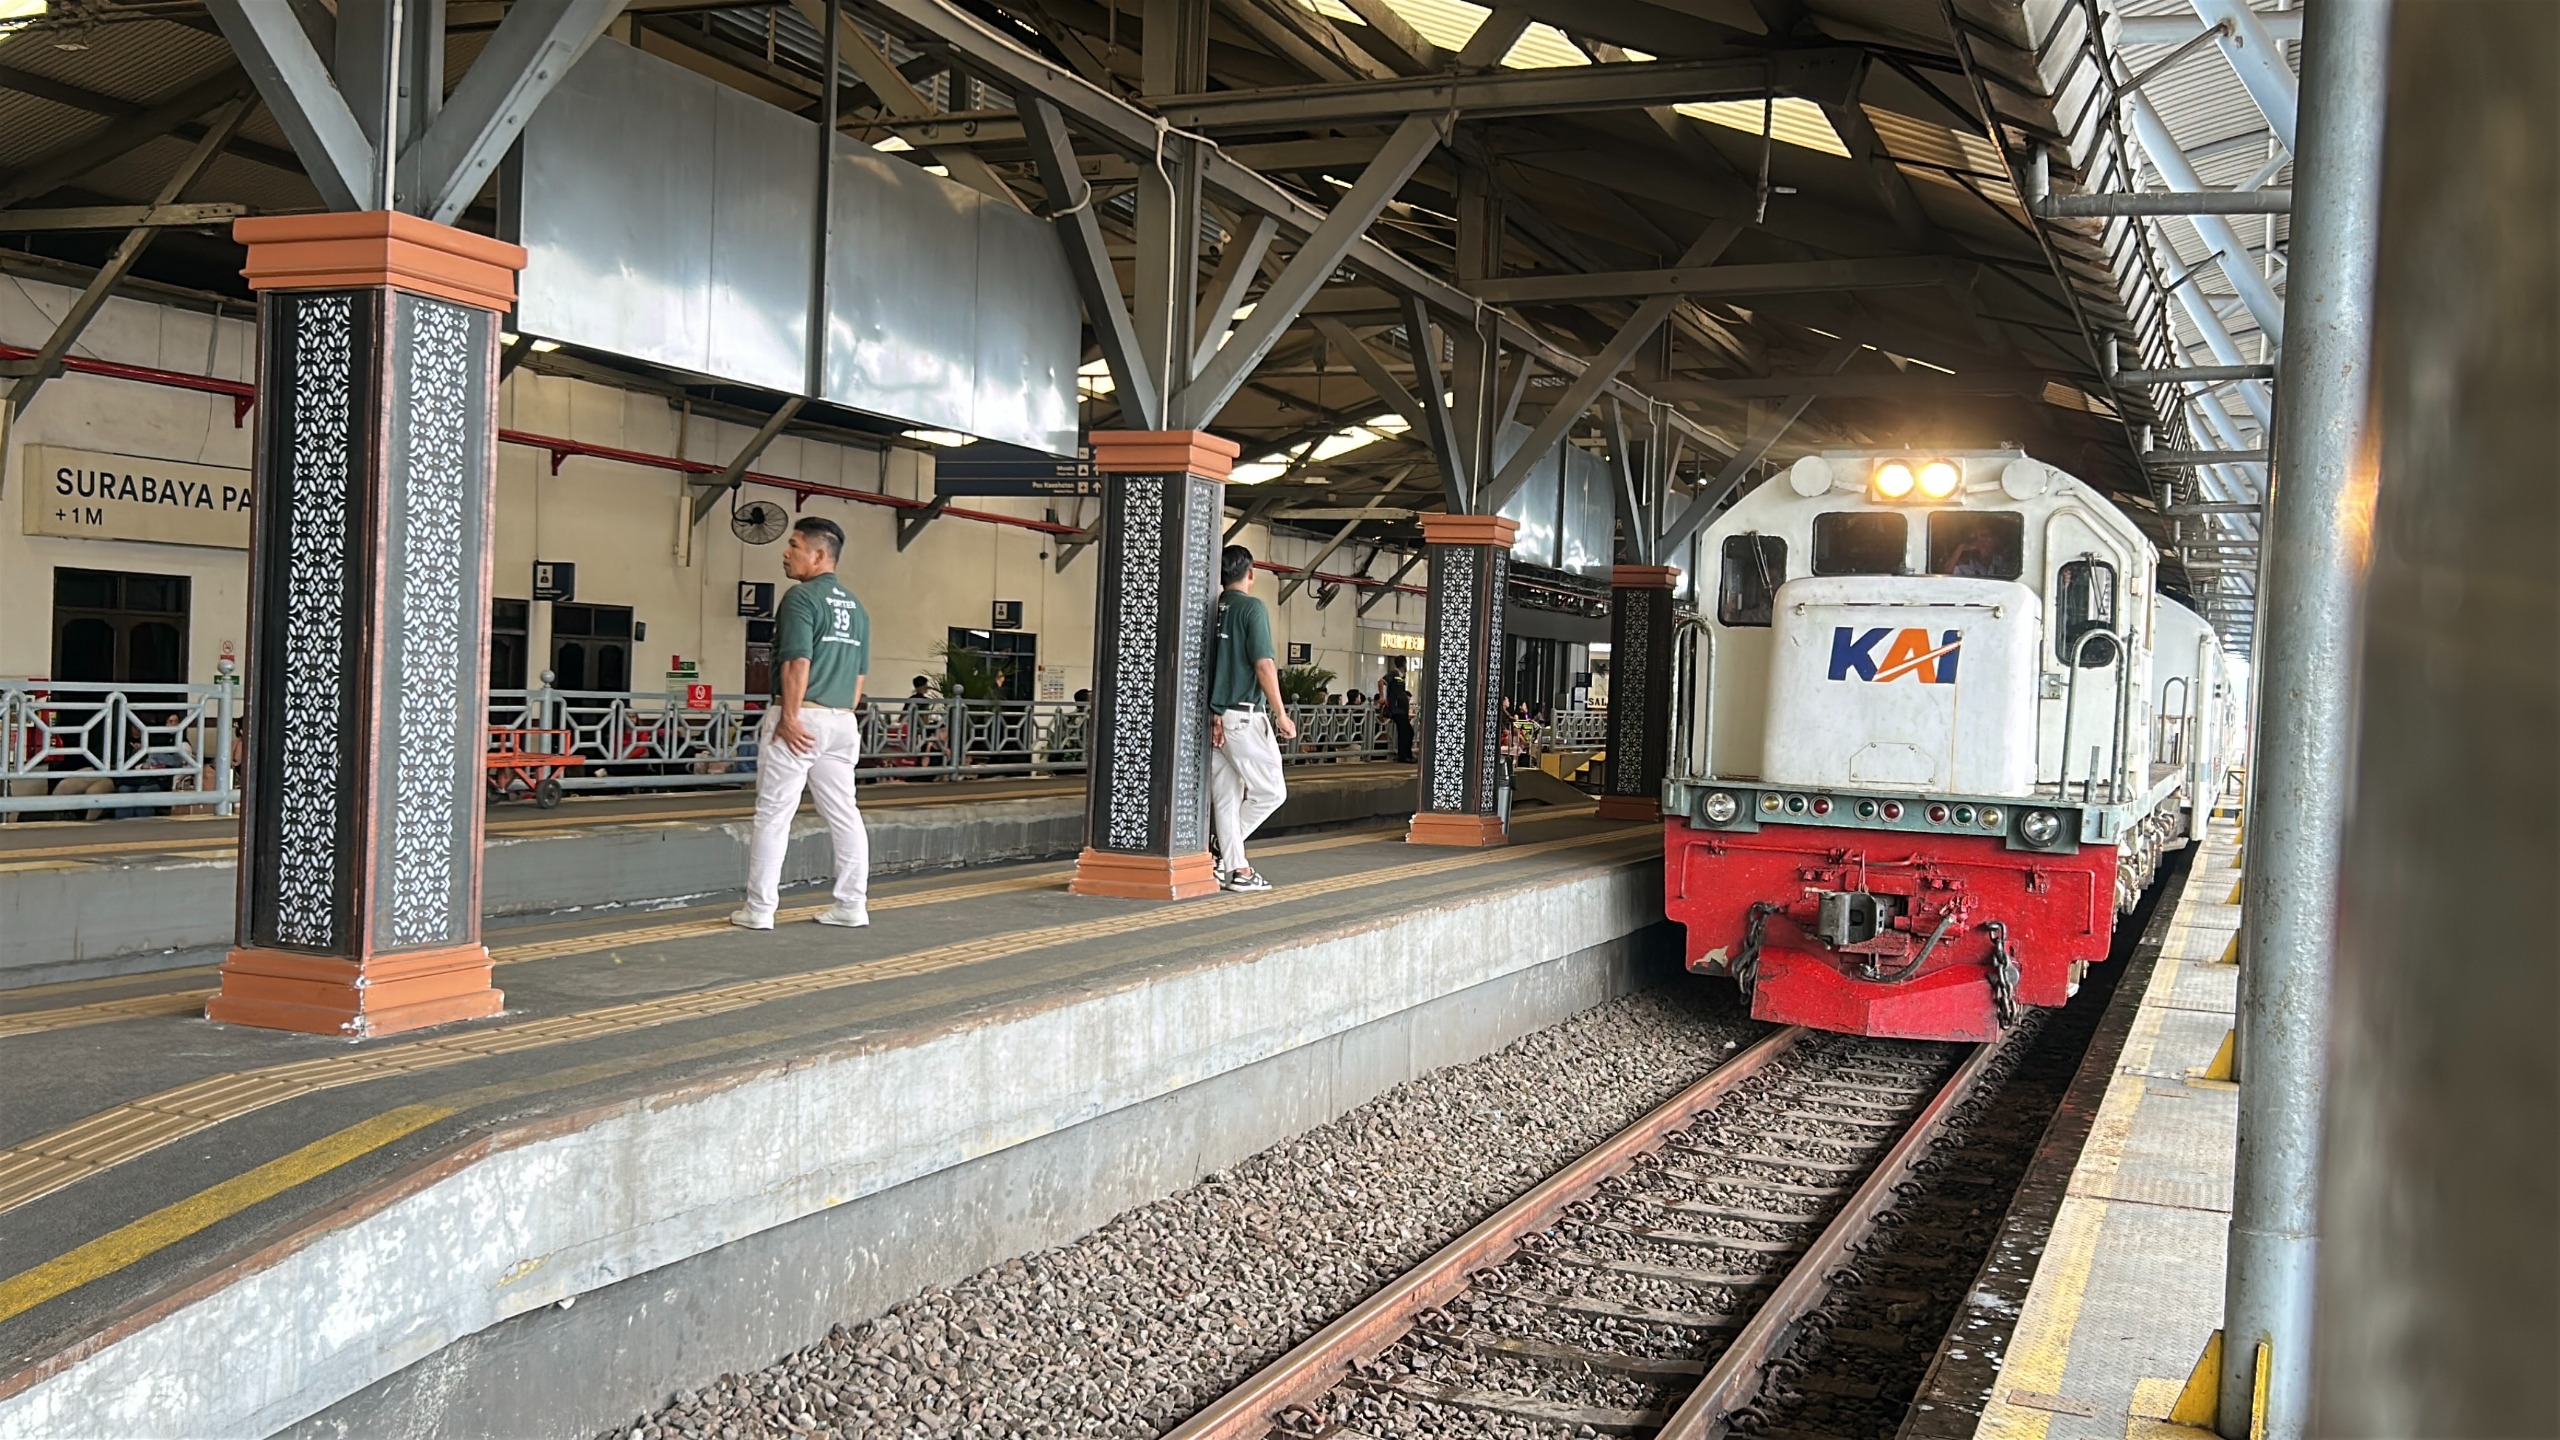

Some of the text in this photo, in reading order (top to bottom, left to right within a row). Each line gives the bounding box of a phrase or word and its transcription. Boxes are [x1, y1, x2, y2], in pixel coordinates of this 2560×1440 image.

[56, 467, 214, 510] SURABAYA
[825, 596, 856, 609] PORTER
[833, 608, 850, 631] 39
[1827, 626, 1963, 684] KAI
